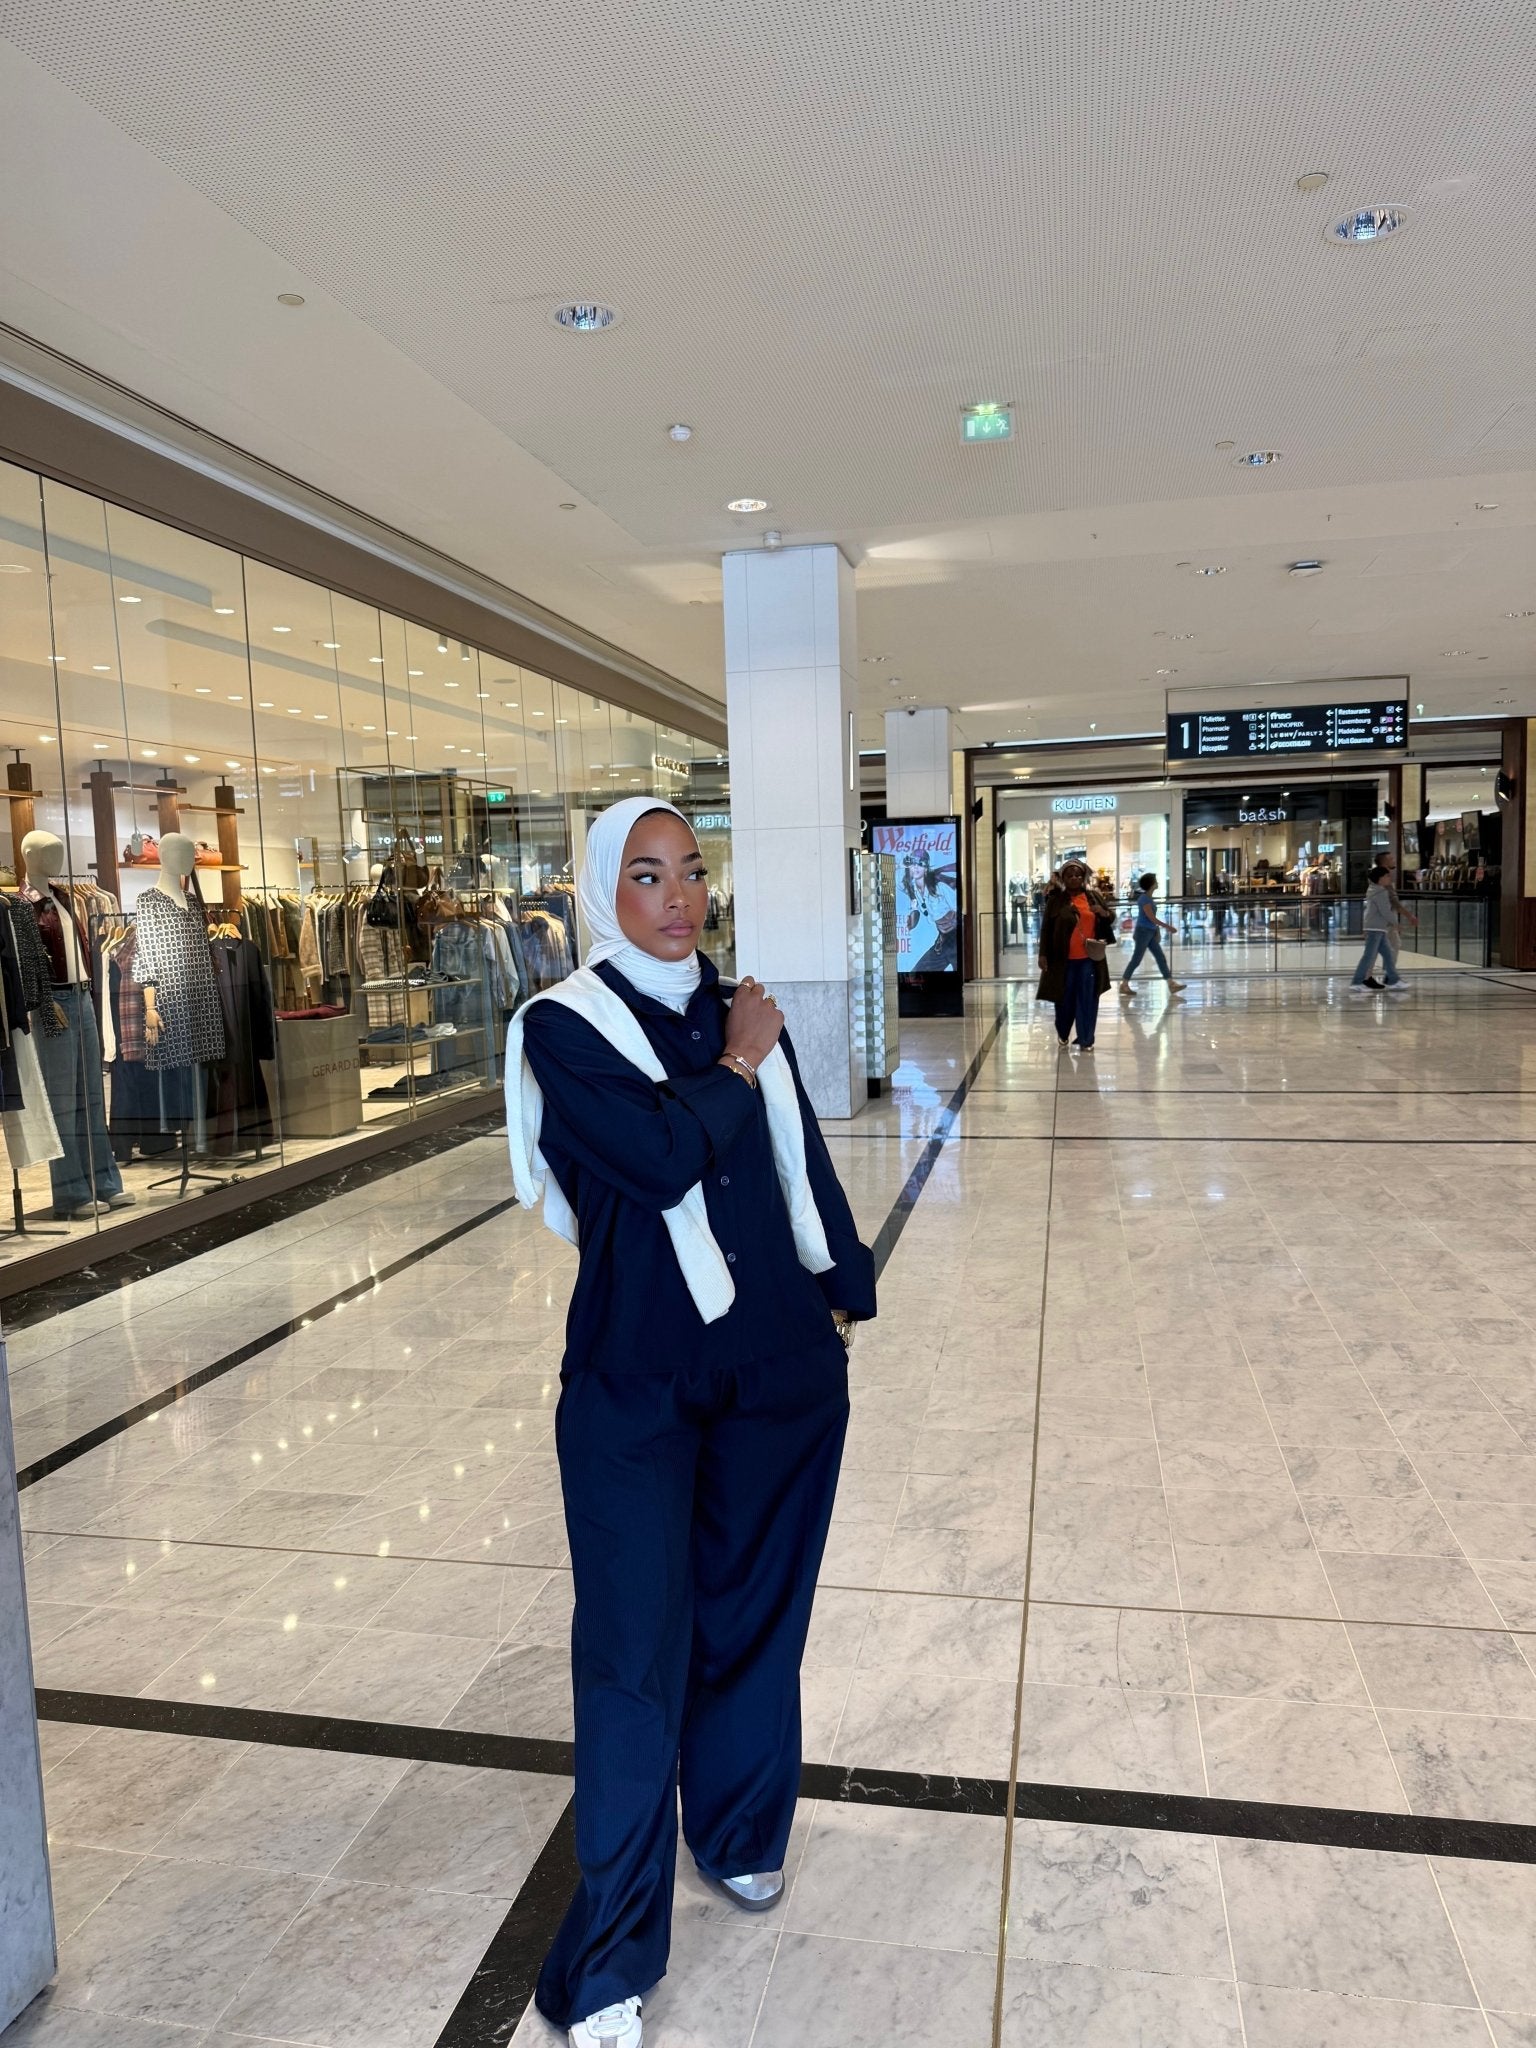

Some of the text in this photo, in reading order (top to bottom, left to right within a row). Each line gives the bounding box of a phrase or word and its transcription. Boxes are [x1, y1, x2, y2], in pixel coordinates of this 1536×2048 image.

[1270, 711, 1292, 720] fnac
[1338, 708, 1371, 716] Restaurants
[1202, 725, 1230, 733] Pharmacie
[1270, 721, 1305, 729] MONOPRIX
[1180, 721, 1190, 749] 1
[1338, 727, 1366, 735] Madeleine
[1054, 797, 1115, 811] KUJTEN
[1239, 807, 1287, 822] ba&sh
[875, 826, 955, 853] Westfield
[312, 1059, 351, 1077] GERARD
